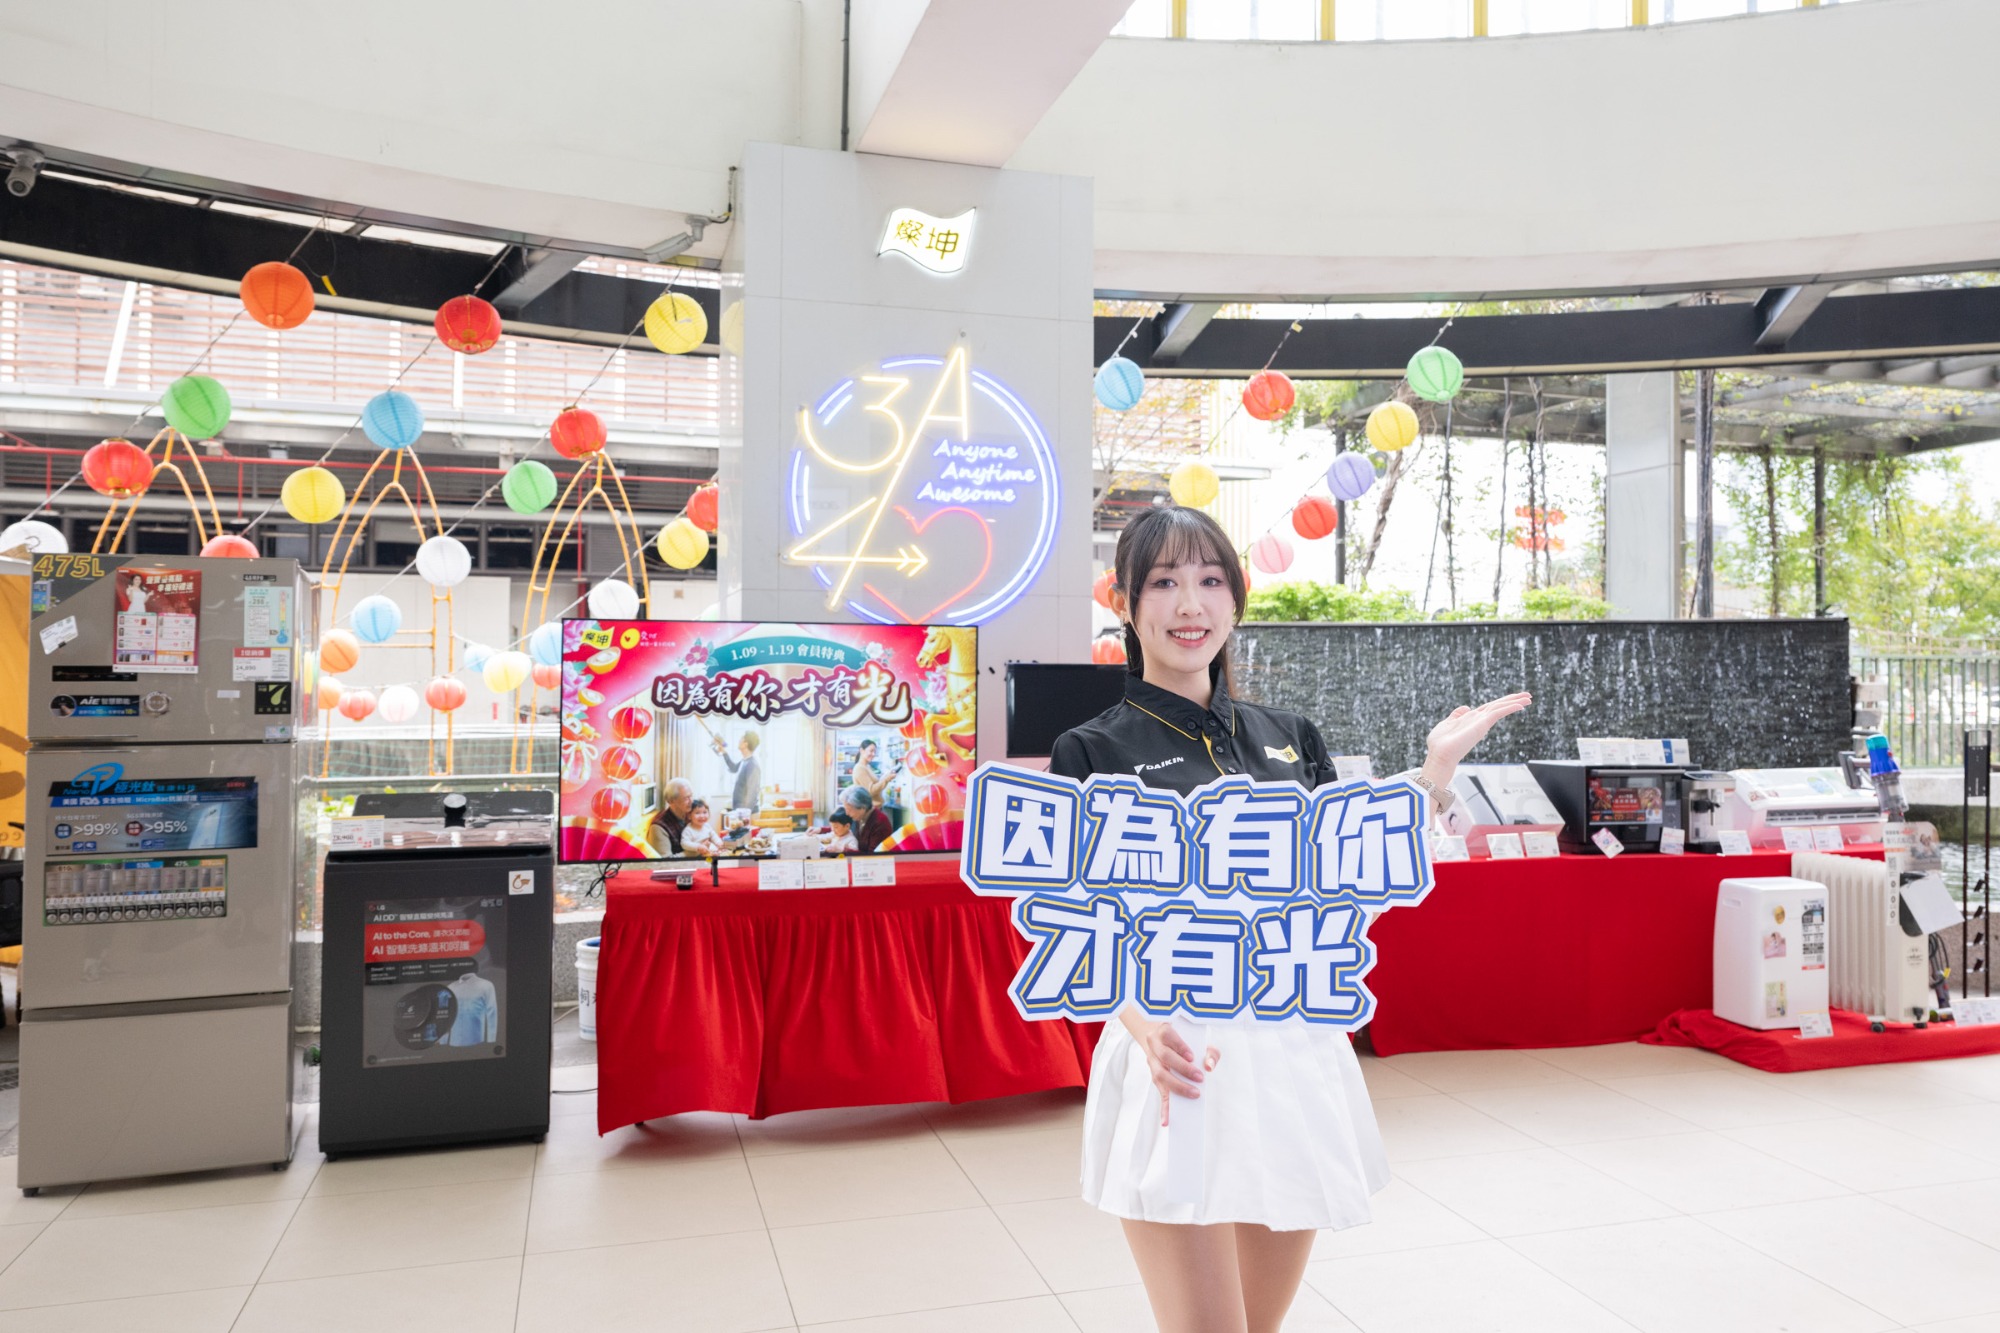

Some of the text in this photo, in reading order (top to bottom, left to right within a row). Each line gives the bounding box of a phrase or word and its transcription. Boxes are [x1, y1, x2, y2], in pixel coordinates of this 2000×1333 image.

[893, 218, 960, 260] 燦坤
[934, 439, 1019, 460] Anyone
[941, 462, 1037, 483] Anytime
[917, 482, 1016, 503] Awesome
[33, 554, 106, 578] 475L
[584, 632, 609, 644] 燦坤
[731, 646, 757, 661] 1.09
[768, 644, 794, 656] 1.19
[797, 643, 846, 663] 會員特典
[657, 664, 910, 725] 因為有你 才有光
[1145, 756, 1185, 771] DAIKIN
[79, 797, 100, 806] FDA
[74, 823, 119, 836] >99%
[143, 820, 188, 833] >95%
[981, 777, 1415, 893] 因為有你
[373, 933, 383, 941] AI
[383, 932, 392, 940] to
[393, 931, 407, 939] the
[372, 946, 384, 955] AI
[1024, 899, 1359, 1012] 才有光
